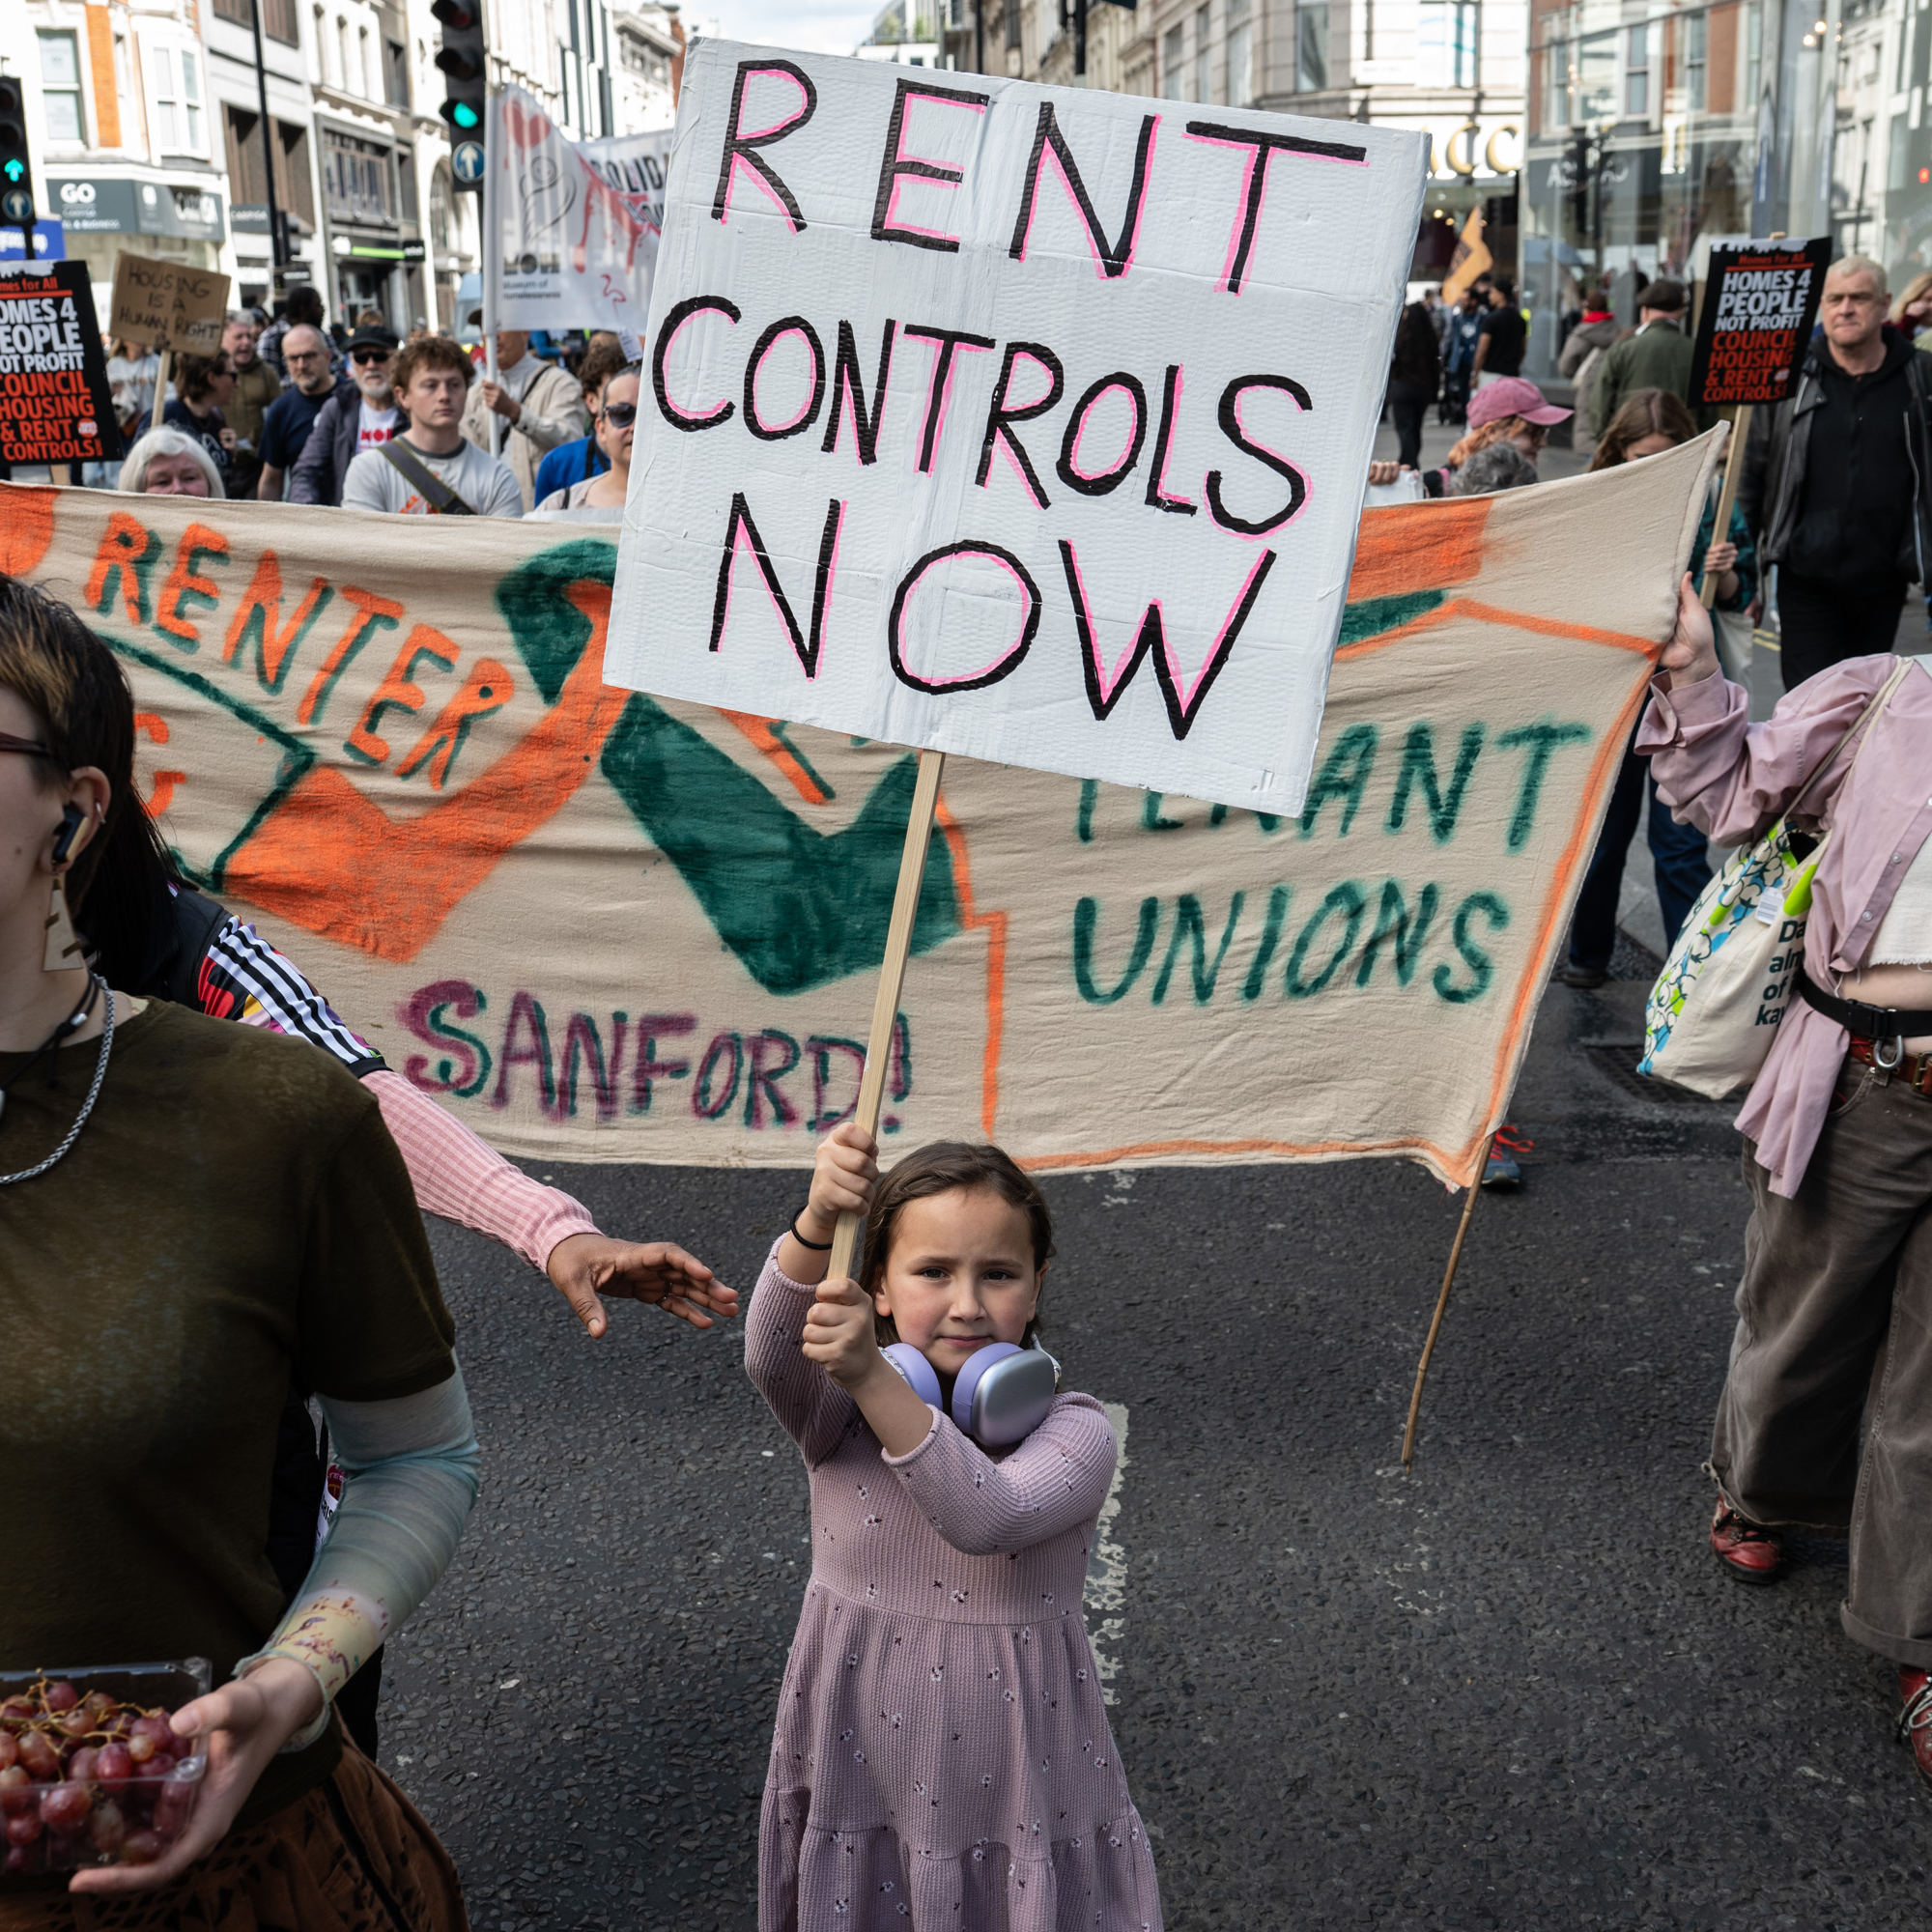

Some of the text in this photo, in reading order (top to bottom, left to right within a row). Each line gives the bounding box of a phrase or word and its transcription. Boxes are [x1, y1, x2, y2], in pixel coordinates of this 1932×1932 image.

[590, 153, 670, 192] SOLID
[712, 59, 1370, 295] RENT
[60, 183, 97, 204] GO
[1775, 253, 1790, 263] for
[1790, 252, 1805, 263] All
[21, 277, 40, 291] for
[43, 276, 58, 290] All
[128, 262, 211, 298] HOUSING
[1722, 269, 1812, 292] HOMES 4
[60, 297, 77, 322] 4
[148, 292, 185, 312] IS A
[1718, 289, 1809, 317] PEOPLE
[119, 306, 219, 339] HUMAN RIGHT
[1714, 313, 1804, 332] NOT PROFIT
[1712, 329, 1797, 351] COUNCIL
[23, 351, 85, 373] PROFIT
[1708, 348, 1794, 369] HOUSING
[1705, 369, 1719, 386] &
[1723, 368, 1773, 385] RENT
[1703, 384, 1787, 402] CONTROLS!
[0, 420, 16, 442] &
[18, 418, 72, 441] RENT
[652, 295, 1314, 541] CONTROLS
[708, 492, 1278, 741] NOW
[84, 512, 514, 791] RENTER
[1072, 876, 1510, 1007] UNIONS
[1763, 976, 1788, 1001] of
[395, 980, 913, 1134] SANFORD!
